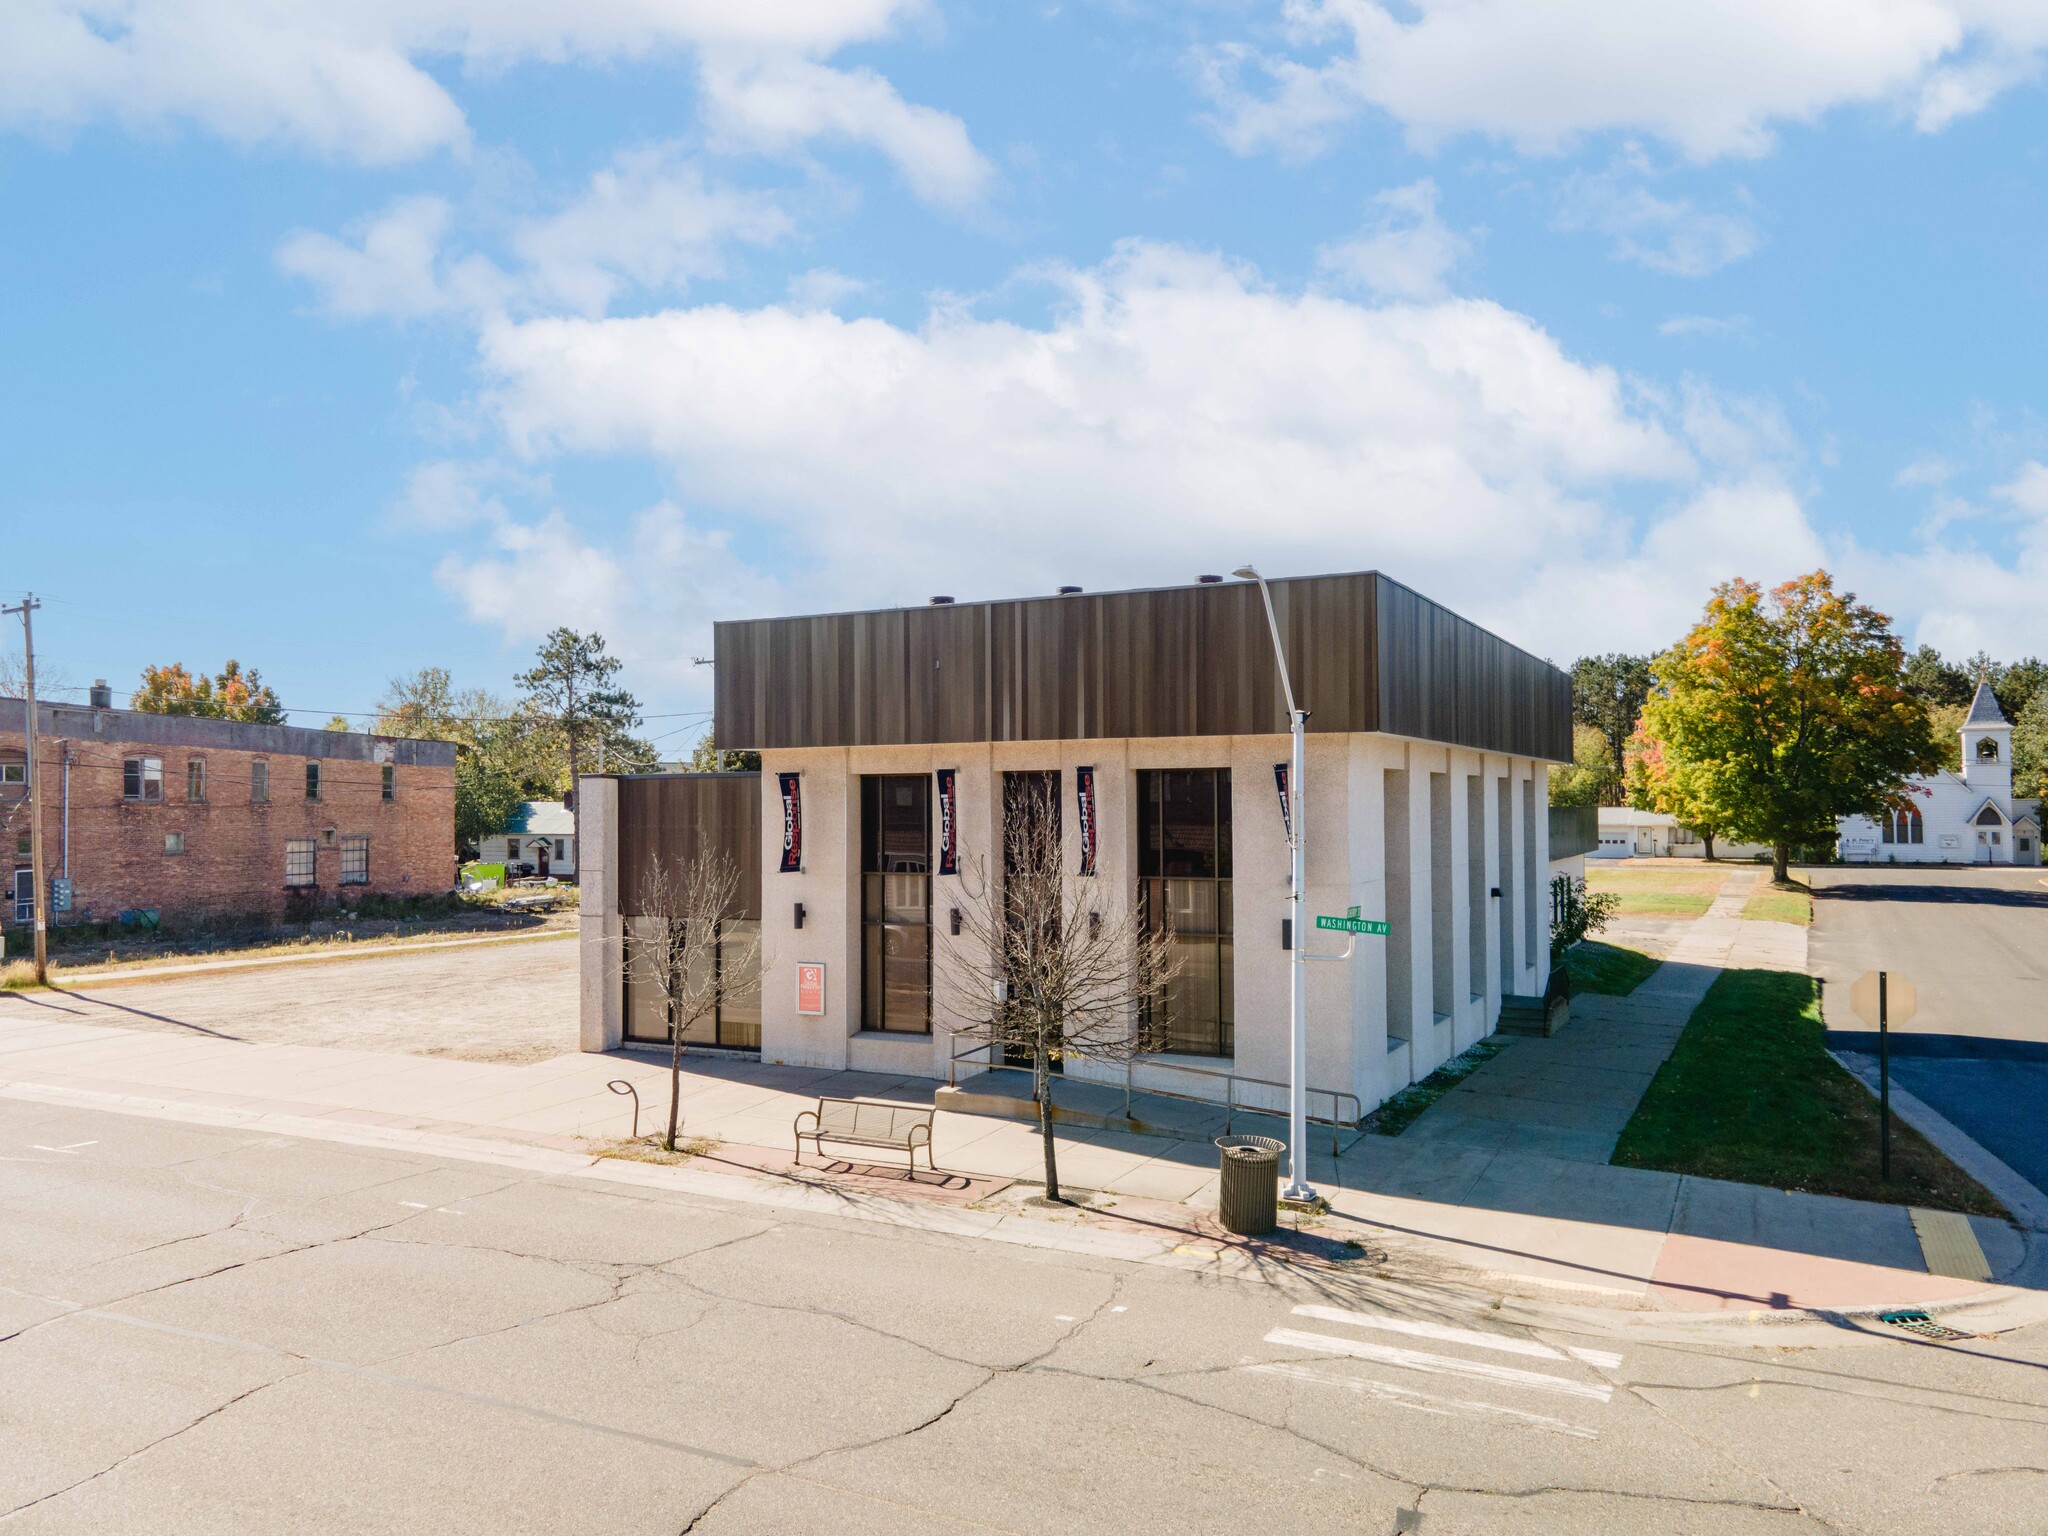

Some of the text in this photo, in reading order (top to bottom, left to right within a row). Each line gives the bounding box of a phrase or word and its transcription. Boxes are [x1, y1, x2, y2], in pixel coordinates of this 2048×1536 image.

[783, 796, 794, 850] Global
[788, 780, 800, 865] Response
[941, 793, 950, 852] Global
[946, 776, 955, 868] Response
[1079, 792, 1090, 853] Global
[1320, 918, 1387, 934] WASHINGTON AV
